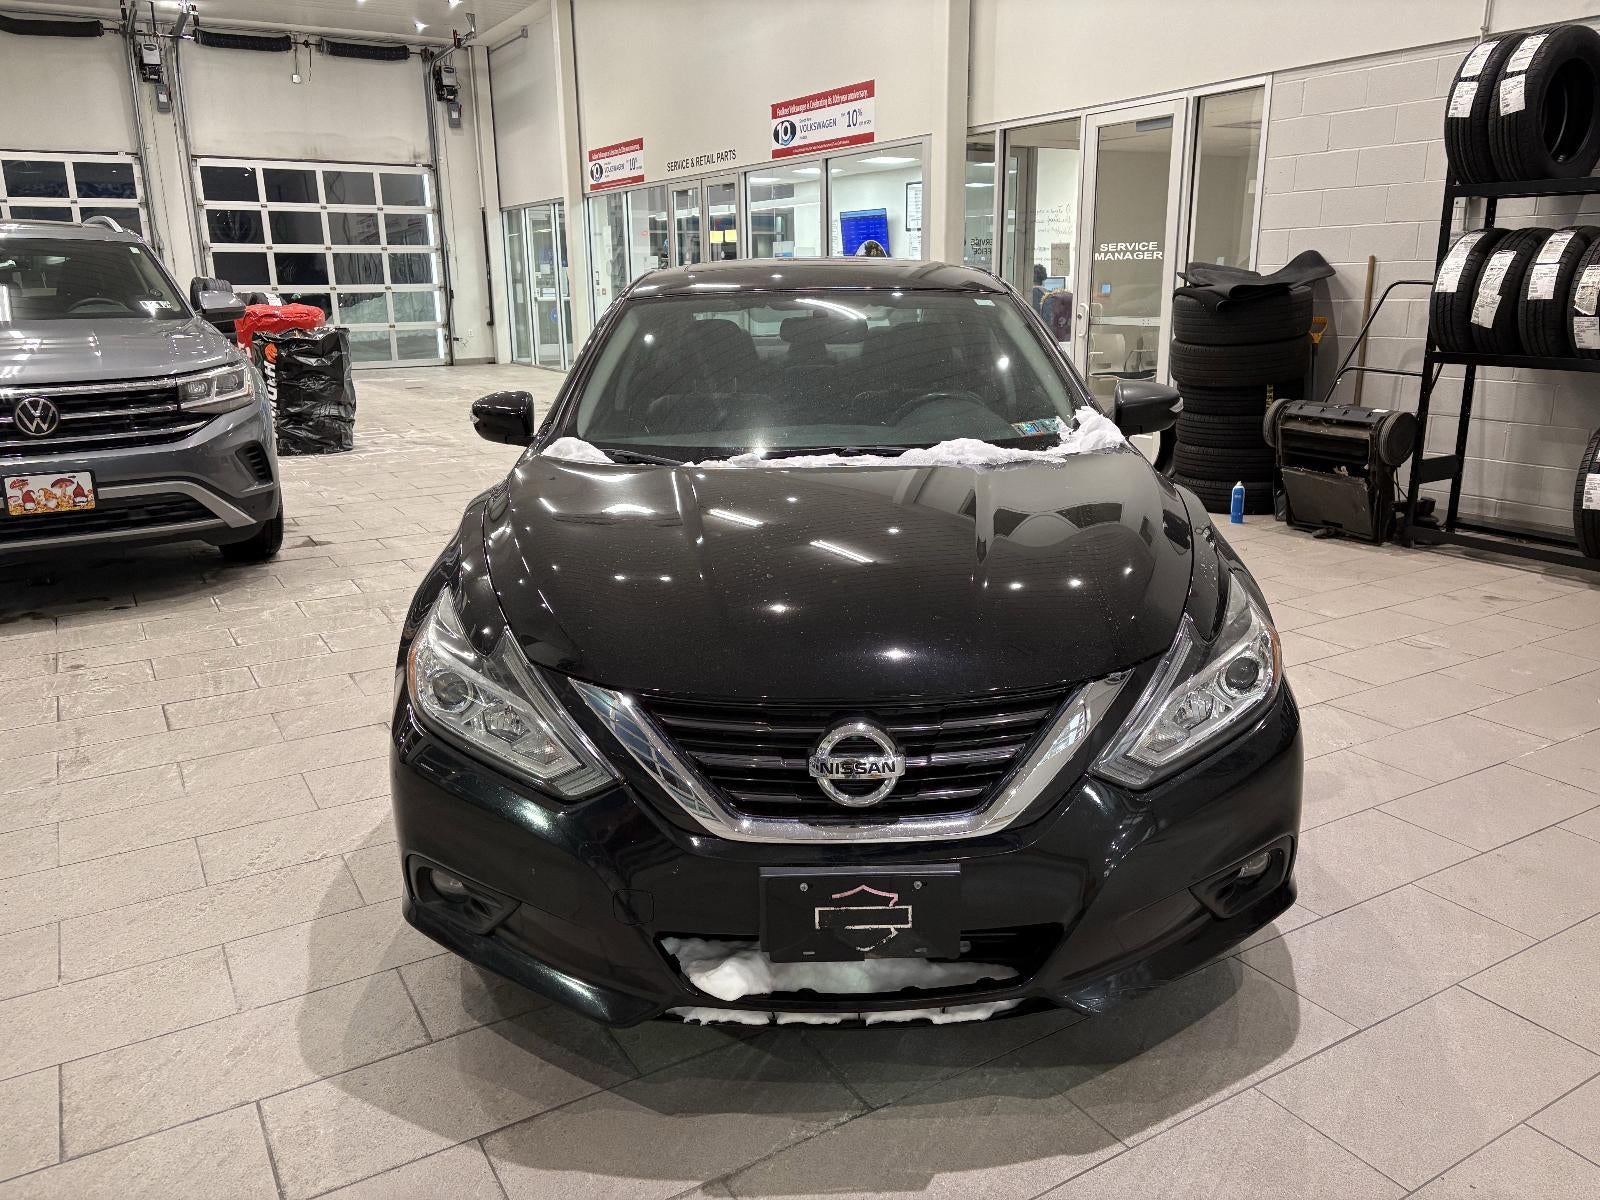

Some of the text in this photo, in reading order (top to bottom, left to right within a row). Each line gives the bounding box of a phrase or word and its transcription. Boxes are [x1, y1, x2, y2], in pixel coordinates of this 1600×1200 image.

[810, 98, 828, 109] Celebrating
[799, 118, 837, 133] VOLKSWAGEN
[666, 149, 737, 172] SERVICE & RETAIL PARTS
[1100, 241, 1158, 252] SERVICE
[1094, 251, 1163, 261] MANAGER
[819, 761, 896, 775] NISSAN
